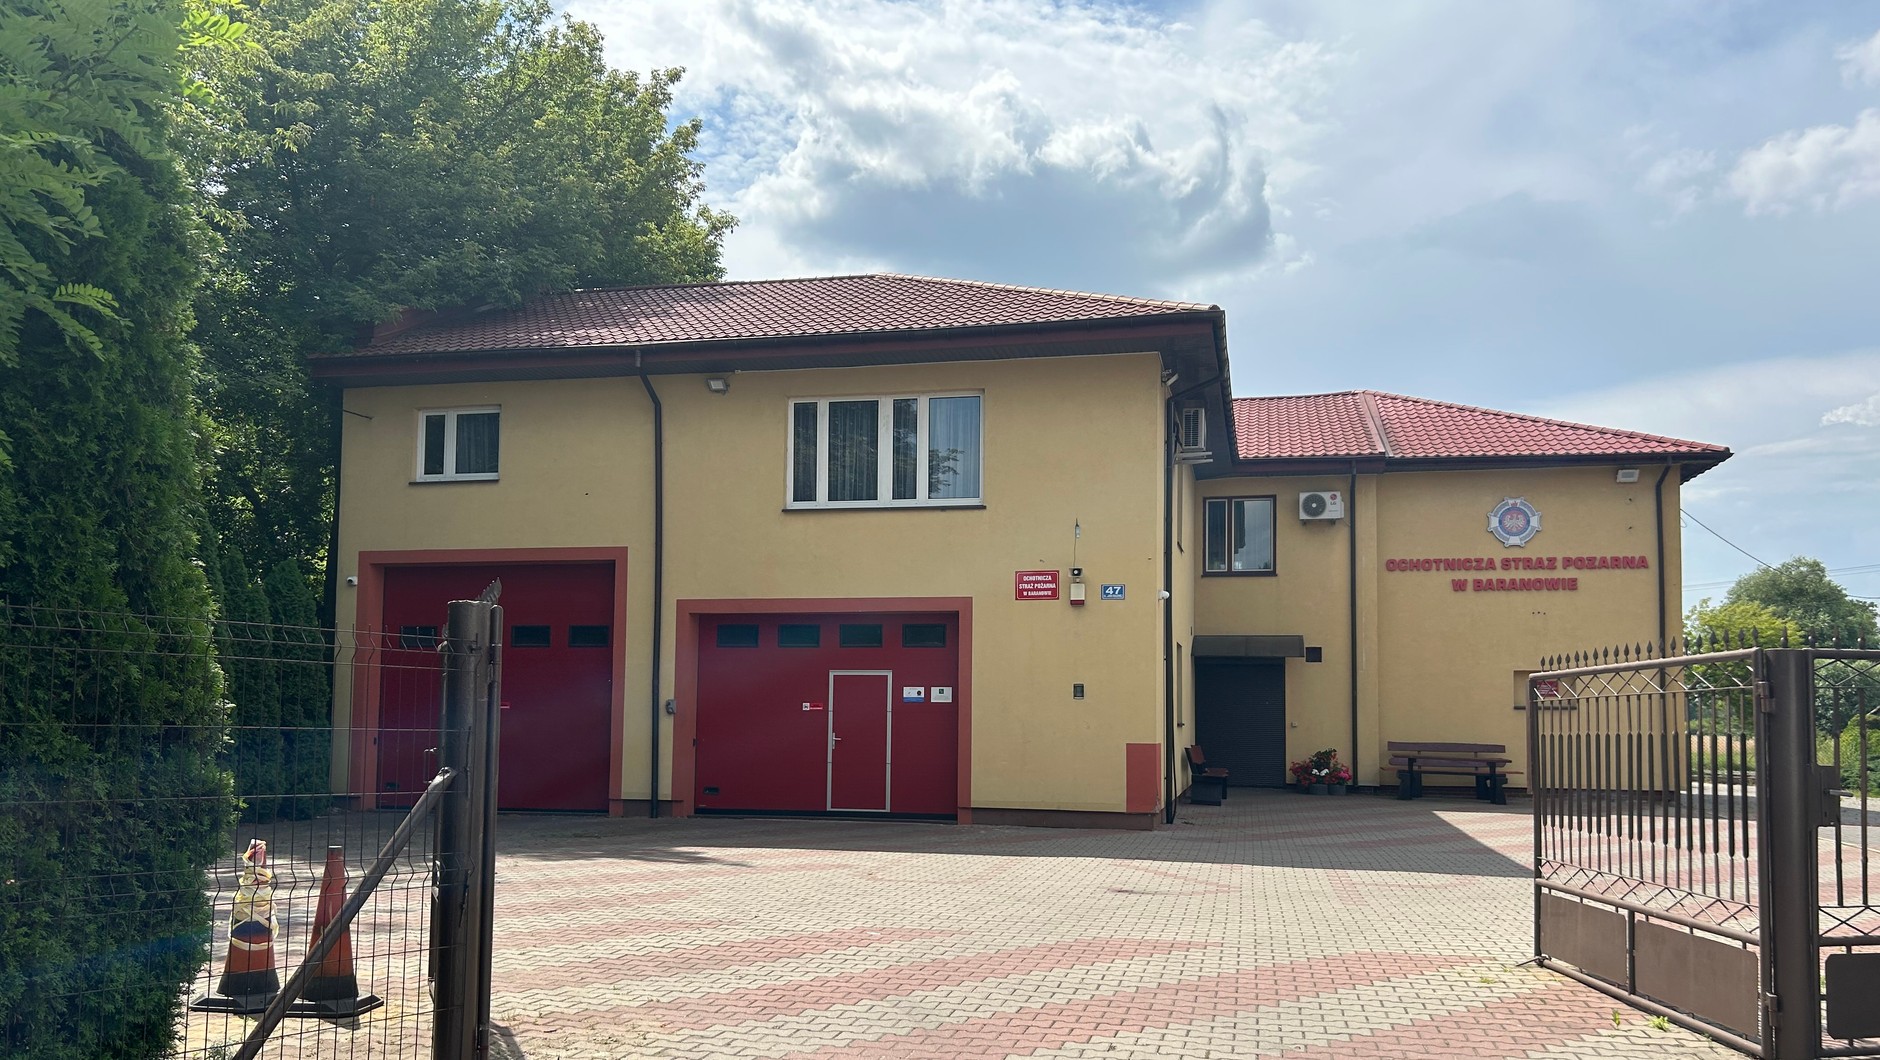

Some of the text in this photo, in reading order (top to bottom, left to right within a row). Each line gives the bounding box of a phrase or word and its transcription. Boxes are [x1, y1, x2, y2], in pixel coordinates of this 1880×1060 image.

[1385, 558, 1496, 572] OCHOTNICZA
[1105, 586, 1121, 595] 47
[1452, 578, 1578, 592] W BARANOWIE
